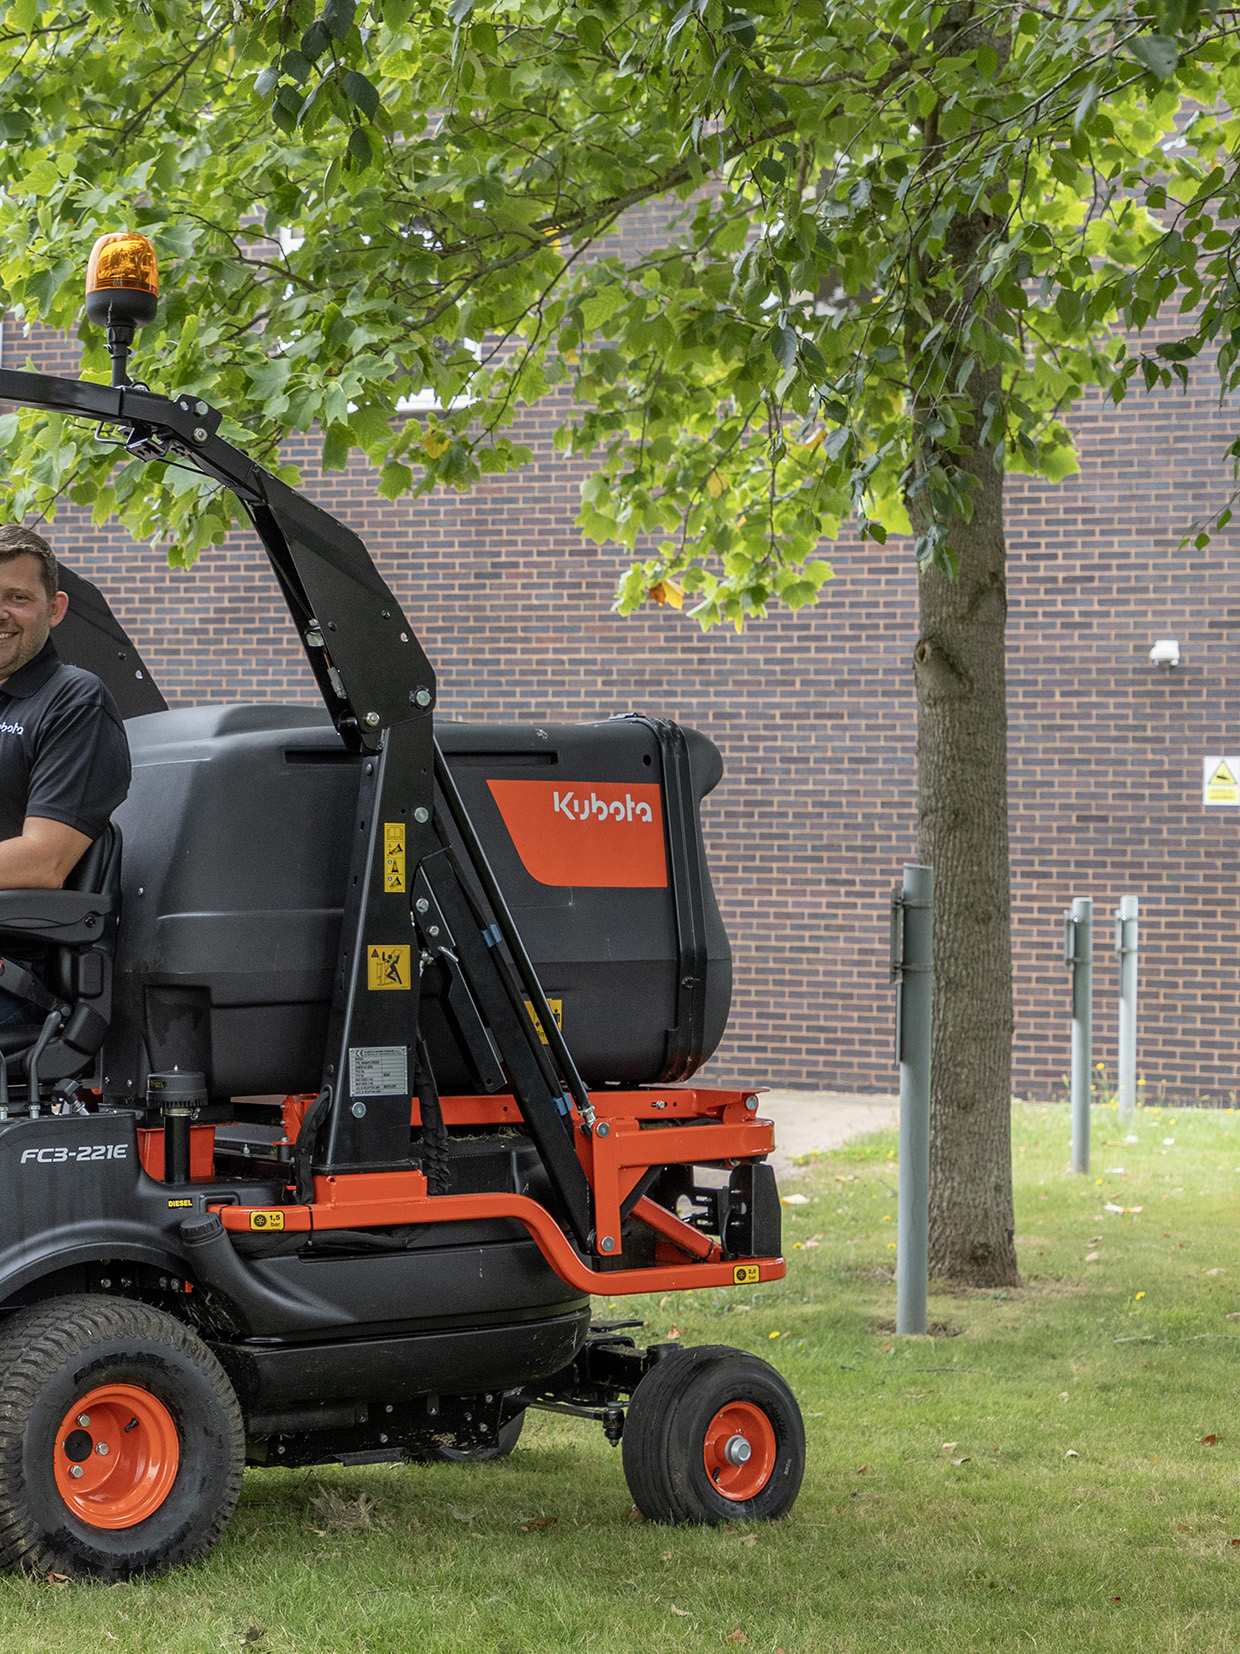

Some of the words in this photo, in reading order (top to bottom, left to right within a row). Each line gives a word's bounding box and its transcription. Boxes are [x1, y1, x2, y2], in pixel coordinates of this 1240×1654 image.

[553, 791, 653, 823] Kubota
[20, 1143, 129, 1165] FC3-221E
[167, 1199, 193, 1208] DIESEL
